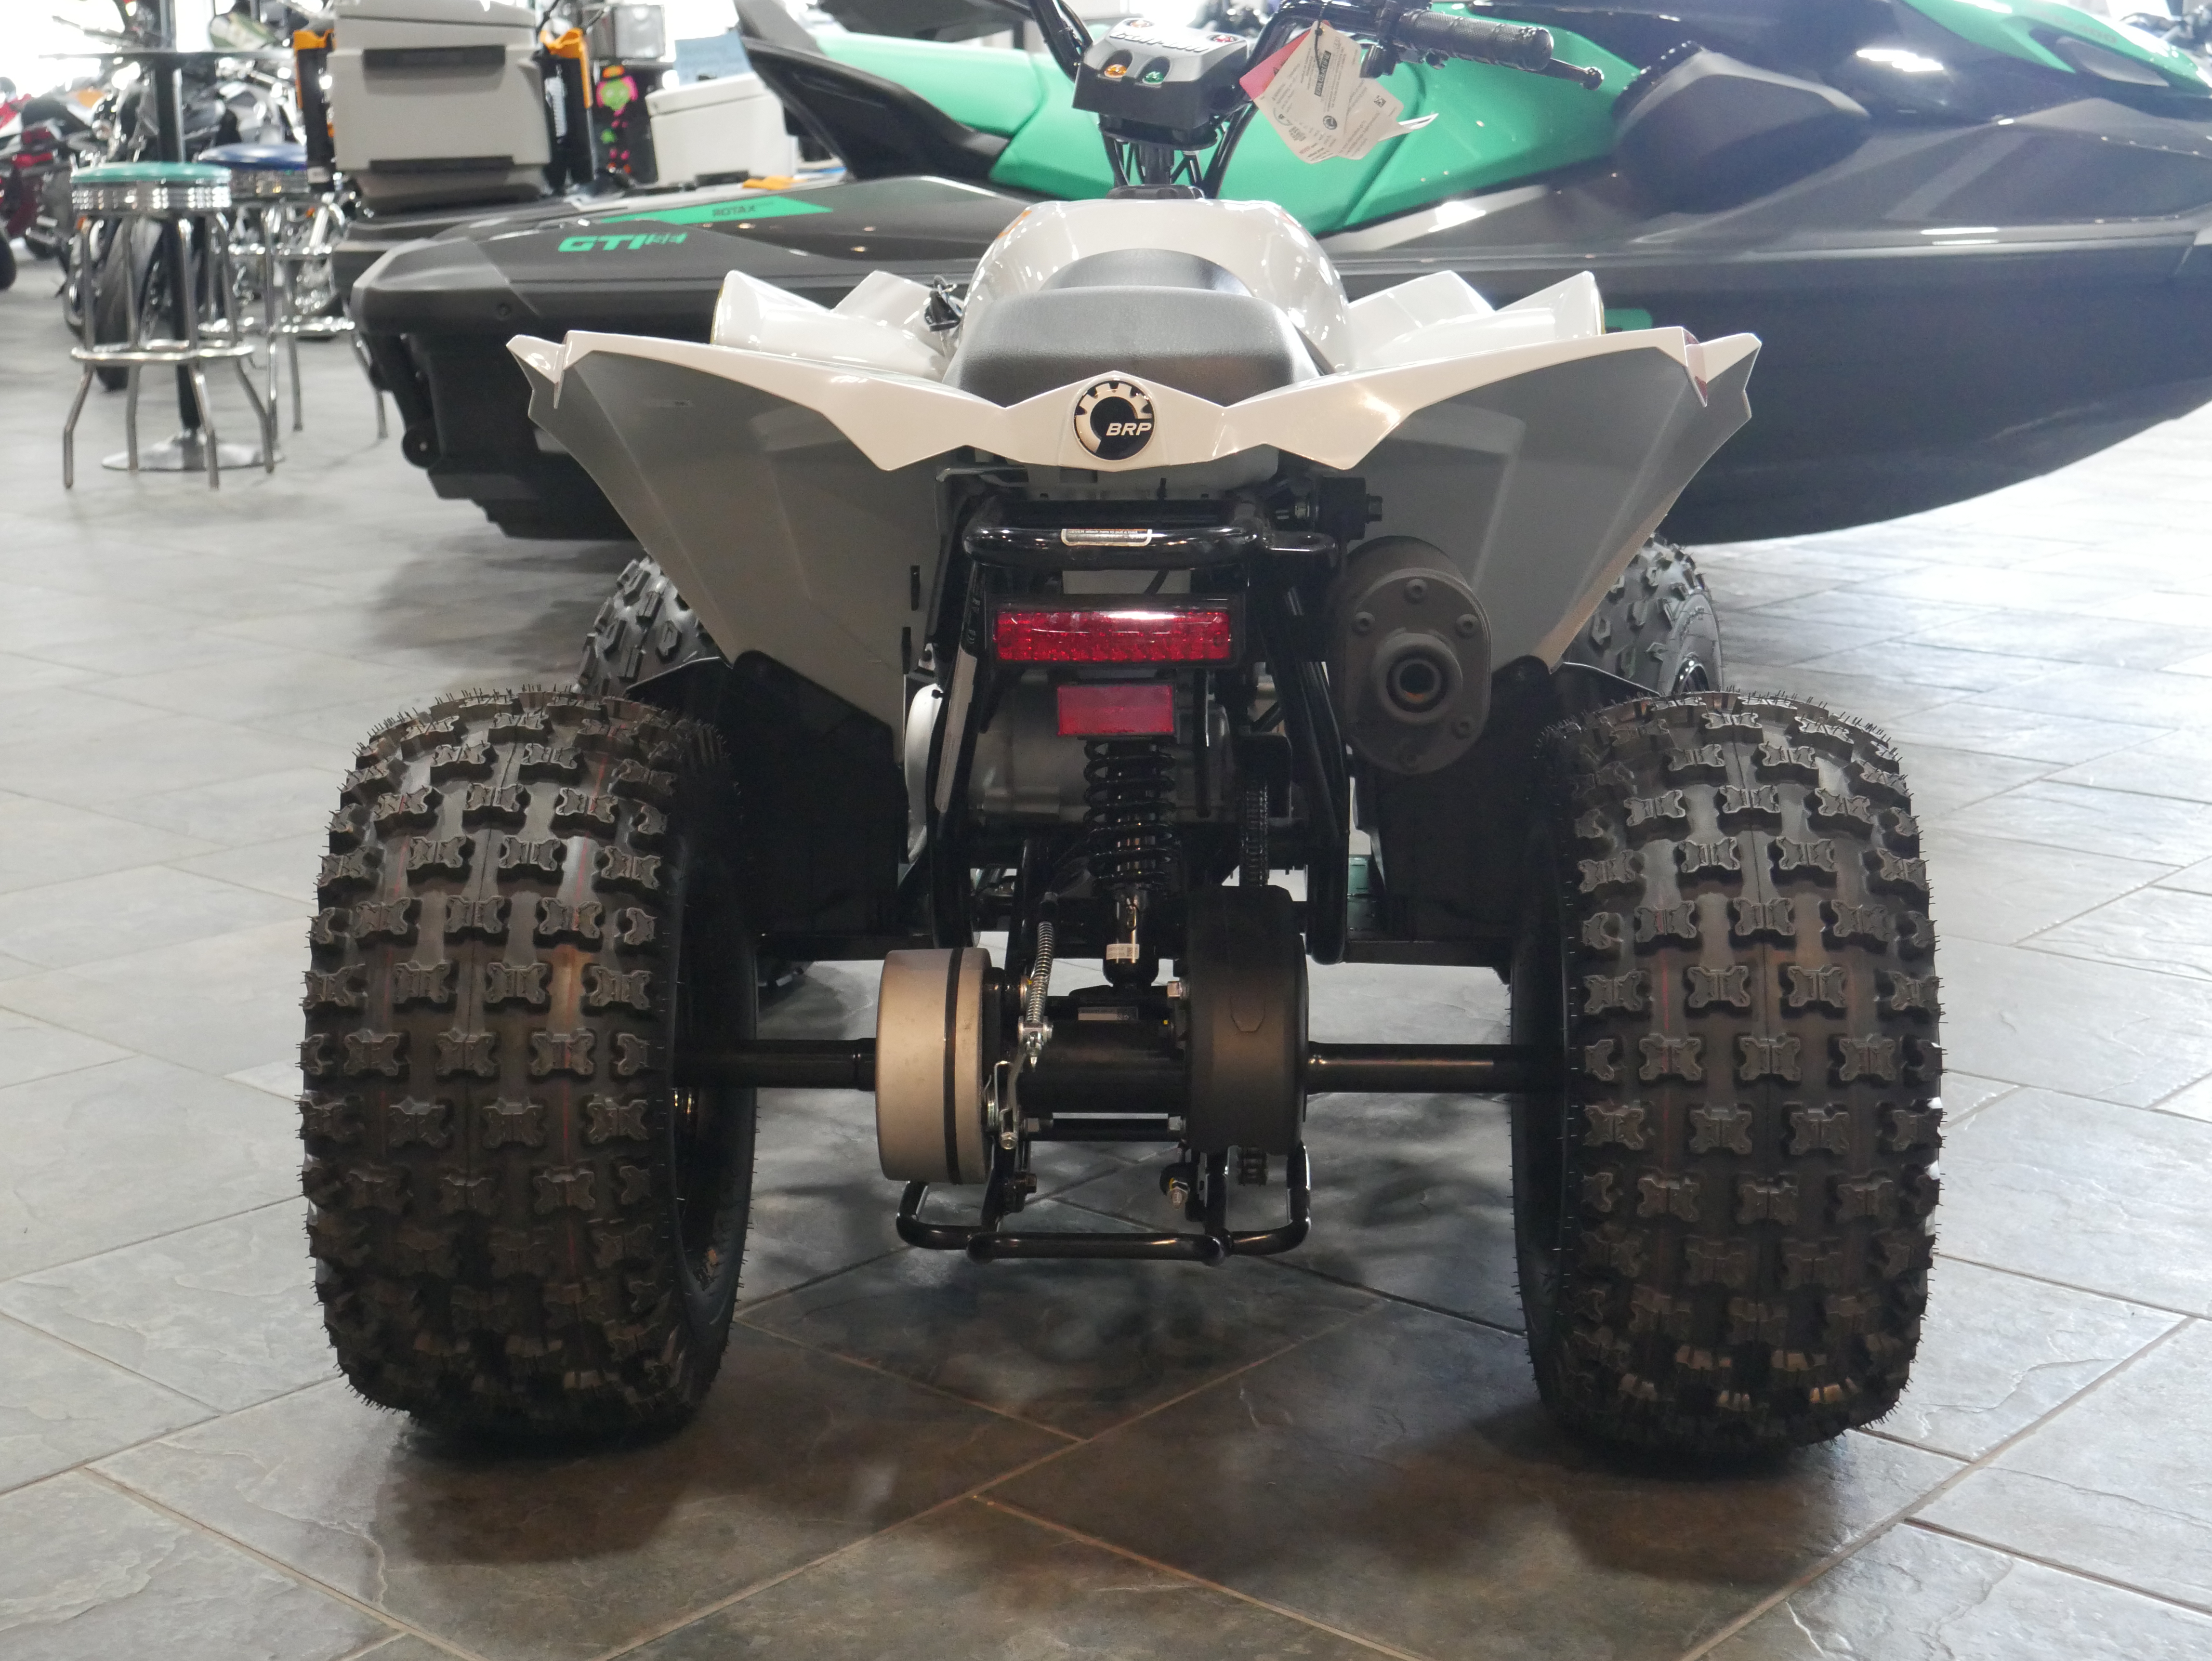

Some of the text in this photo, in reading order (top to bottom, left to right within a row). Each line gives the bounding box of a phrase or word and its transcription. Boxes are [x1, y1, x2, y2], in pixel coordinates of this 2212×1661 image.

[712, 204, 755, 216] ROTAX
[558, 234, 650, 252] GTI
[1106, 422, 1152, 436] BRP
